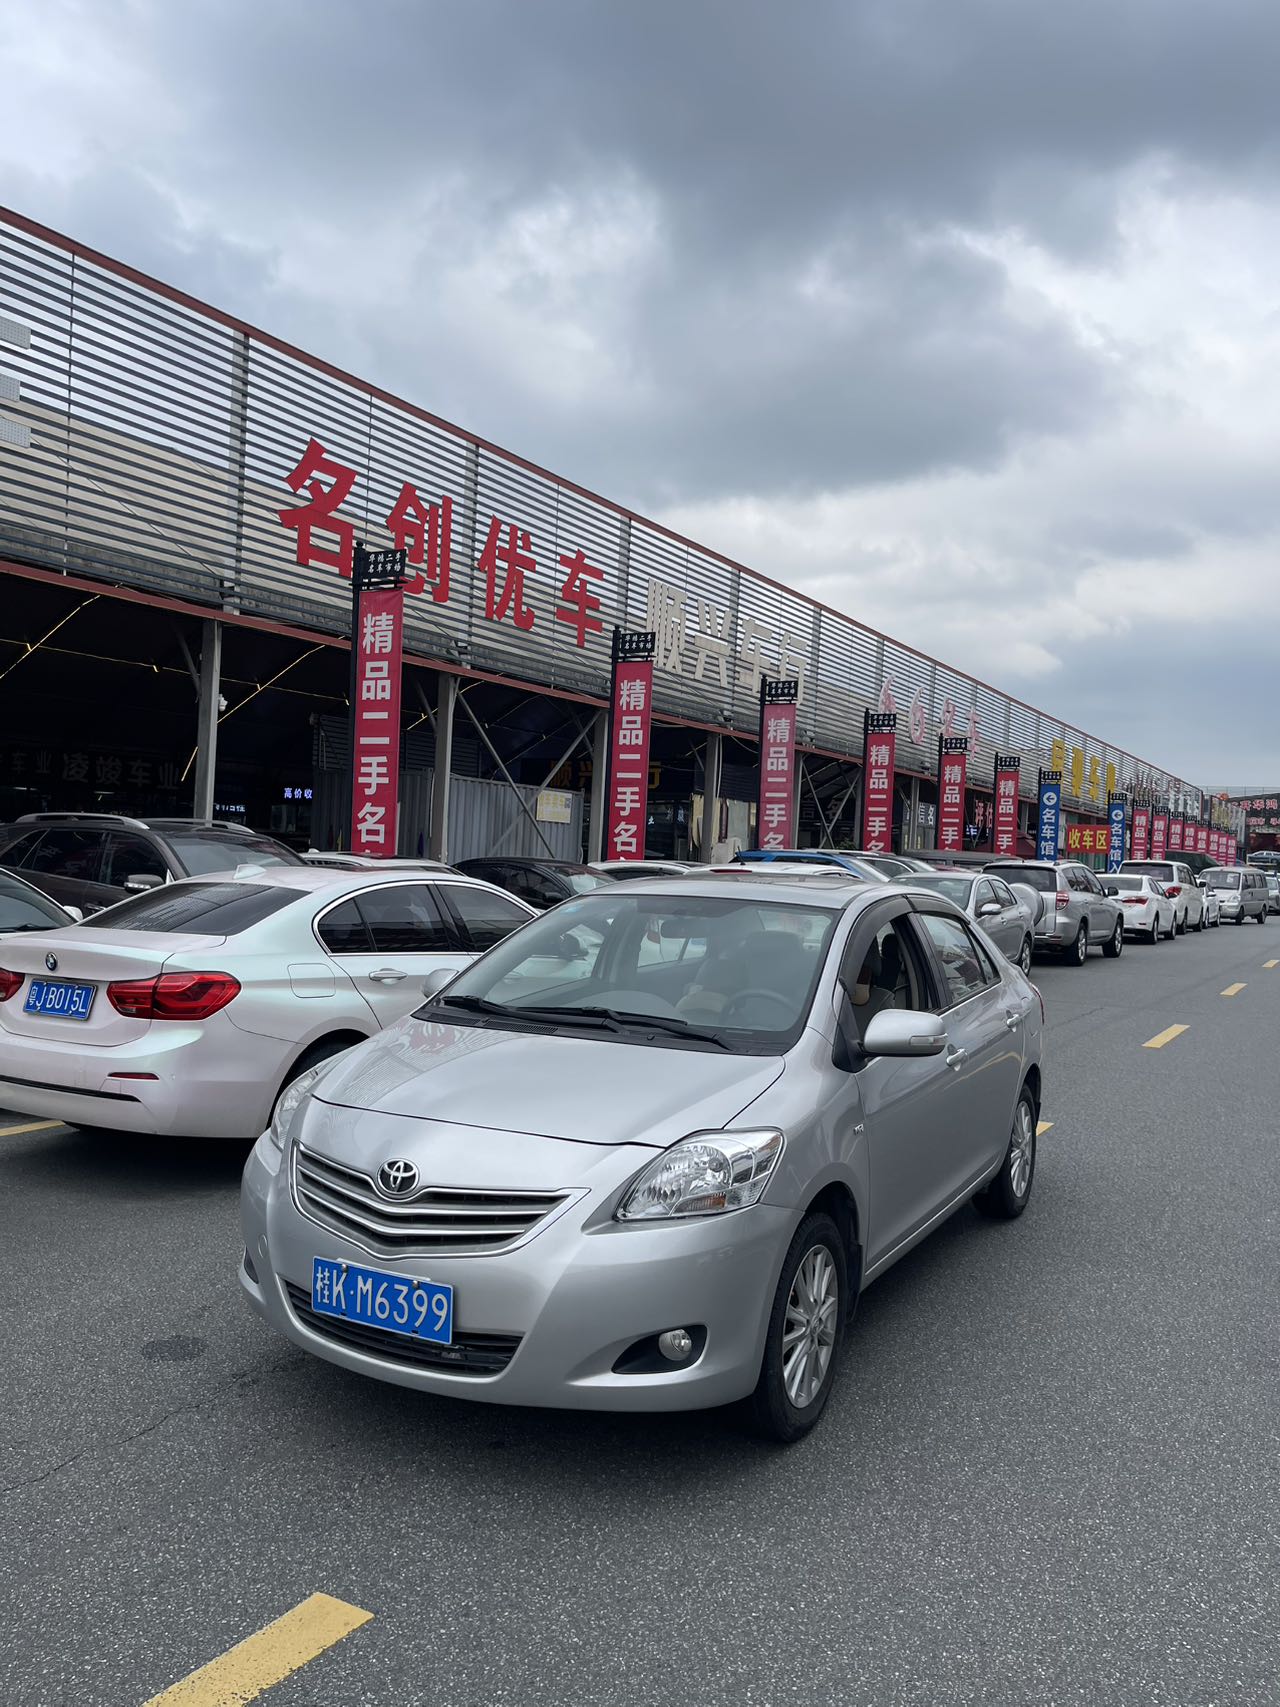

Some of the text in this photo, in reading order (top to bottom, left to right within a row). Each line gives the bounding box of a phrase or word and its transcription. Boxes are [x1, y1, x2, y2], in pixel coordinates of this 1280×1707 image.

[277, 437, 604, 648] 名创优车
[357, 612, 394, 853] 精品二手名
[613, 679, 646, 860] 精品二手名
[284, 787, 312, 799] 高价收
[941, 764, 962, 851] 精品二手
[997, 779, 1015, 855] 精品二手
[1069, 828, 1107, 850] 收车区
[315, 1266, 449, 1332] 桂K·M6399
